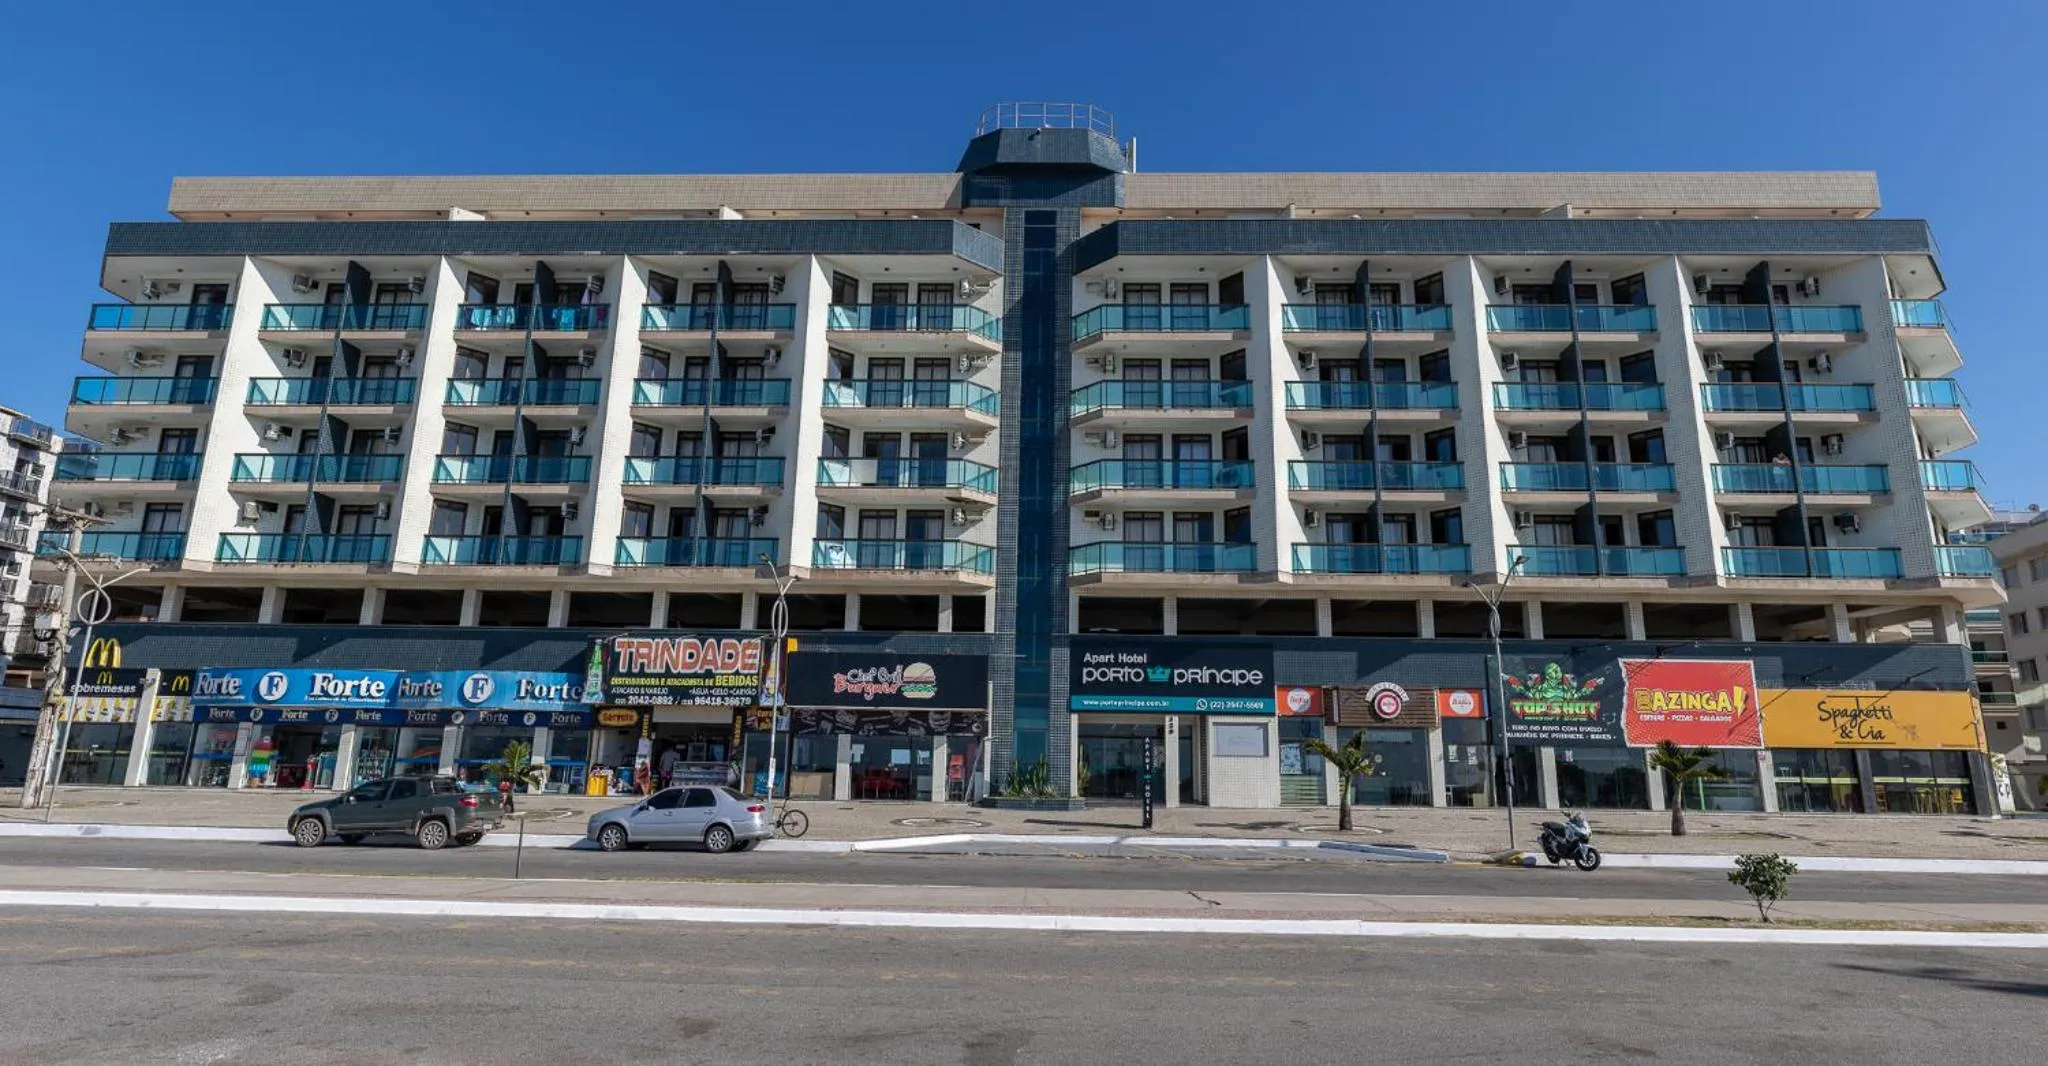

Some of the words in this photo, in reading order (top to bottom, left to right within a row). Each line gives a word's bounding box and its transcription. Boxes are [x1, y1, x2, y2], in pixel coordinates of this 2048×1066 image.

[614, 638, 760, 674] TRINDADE
[1083, 652, 1115, 664] Apart
[1118, 652, 1147, 663] Hotel
[196, 673, 242, 695] Forte
[264, 676, 284, 697] F
[310, 672, 386, 698] Forte
[398, 677, 443, 697] Forte
[715, 675, 759, 687] BEBIDAS
[70, 684, 137, 694] sobremesas
[469, 678, 488, 700] F
[516, 679, 582, 699] Forte
[208, 708, 236, 719] Forte
[281, 709, 309, 720] Forte
[355, 710, 382, 720] Forte
[1512, 701, 1546, 713] TOP
[1550, 702, 1597, 715] SHOT
[1817, 697, 1892, 728] Spaghetti
[407, 710, 437, 721] Forte
[480, 711, 509, 722] Forte
[551, 711, 581, 723] Forte
[1840, 727, 1852, 738] &
[1857, 719, 1886, 740] Cia
